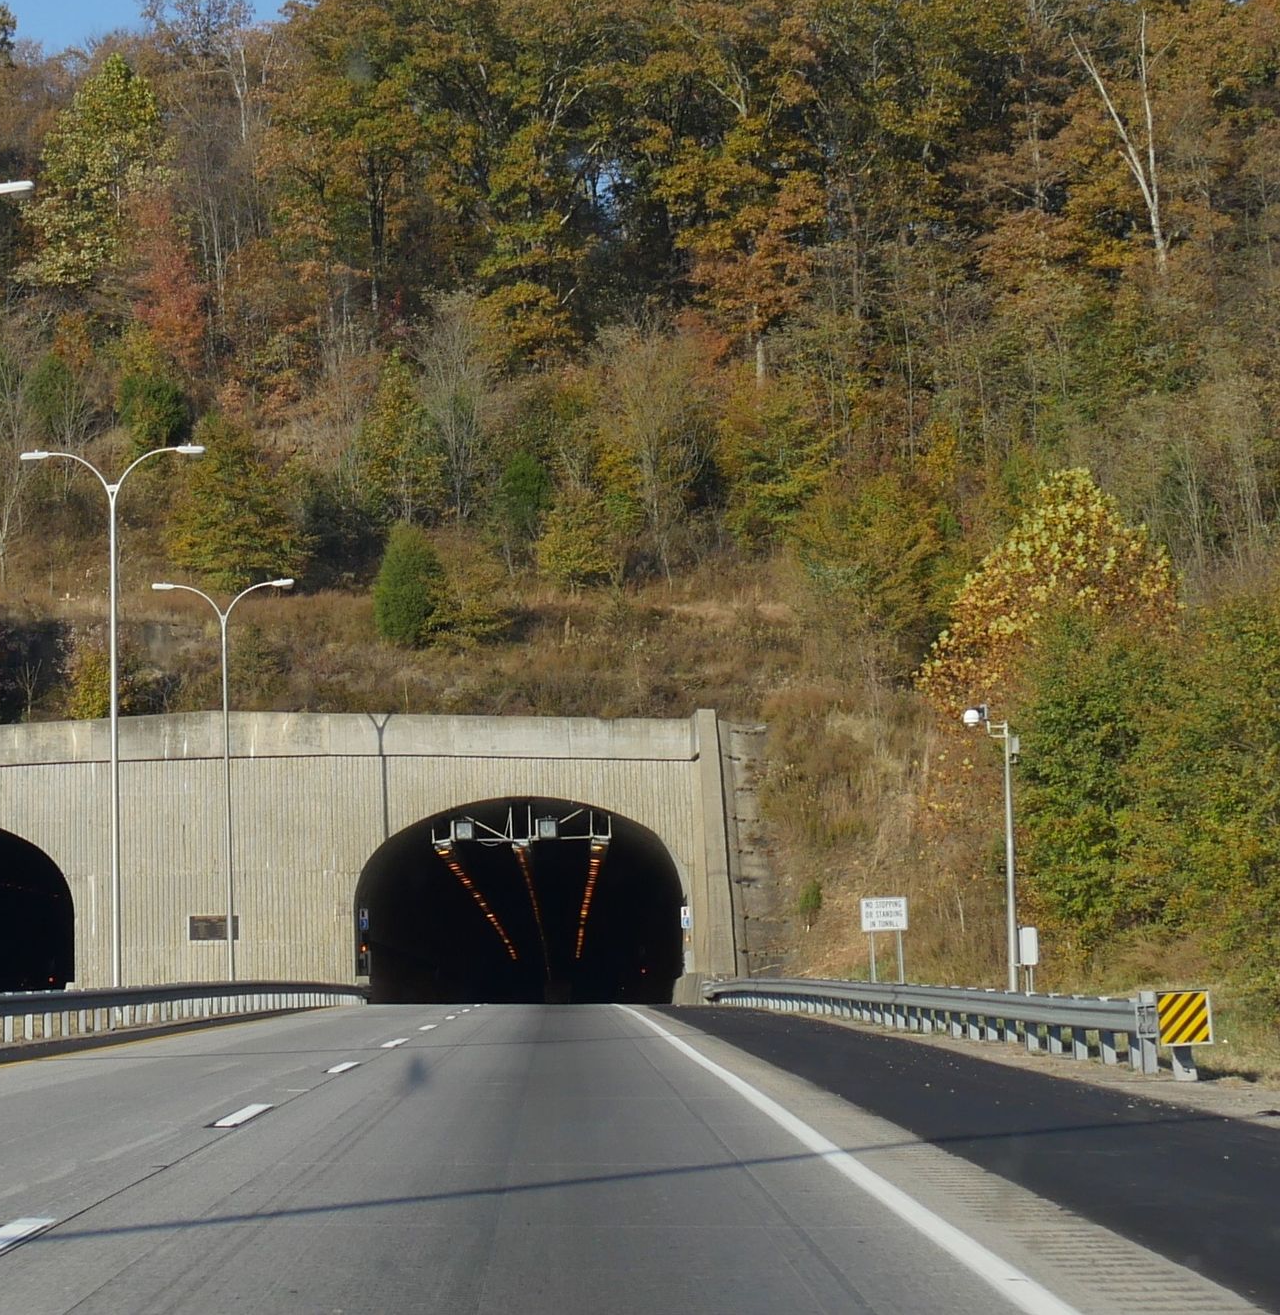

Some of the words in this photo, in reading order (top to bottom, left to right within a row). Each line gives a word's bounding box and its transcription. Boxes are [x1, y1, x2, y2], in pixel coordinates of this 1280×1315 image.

[865, 901, 873, 909] NO
[875, 900, 902, 909] STOPPING
[865, 910, 873, 918] OR
